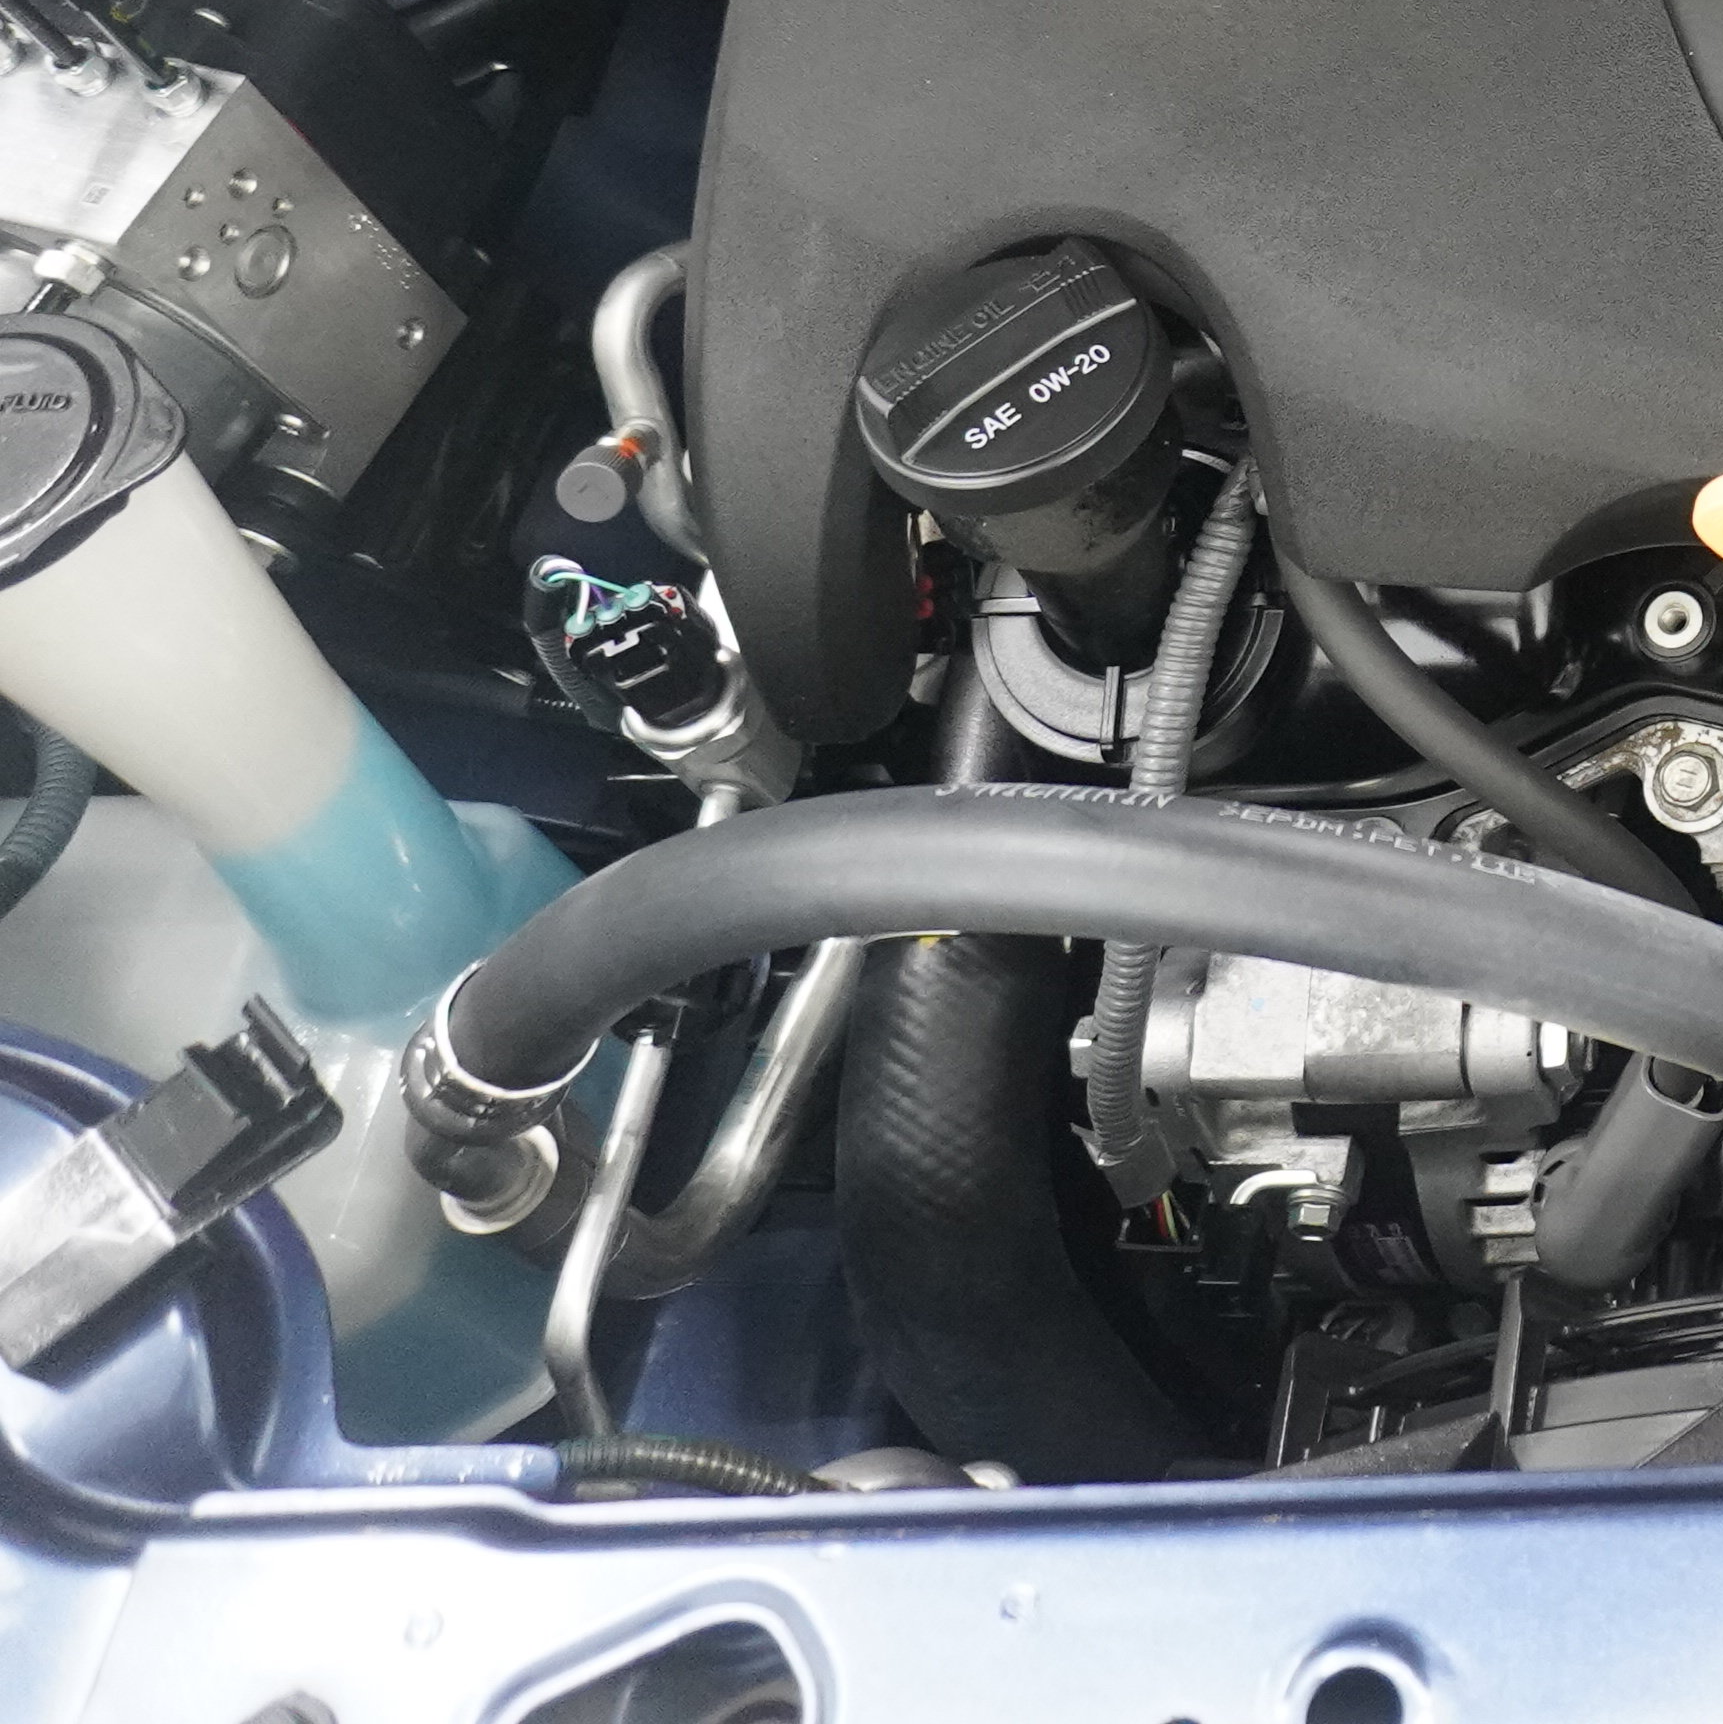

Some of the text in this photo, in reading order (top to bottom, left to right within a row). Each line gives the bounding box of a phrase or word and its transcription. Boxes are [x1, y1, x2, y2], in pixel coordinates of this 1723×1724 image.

[972, 298, 1016, 329] OIL
[964, 343, 1112, 450] SAE 0W-20
